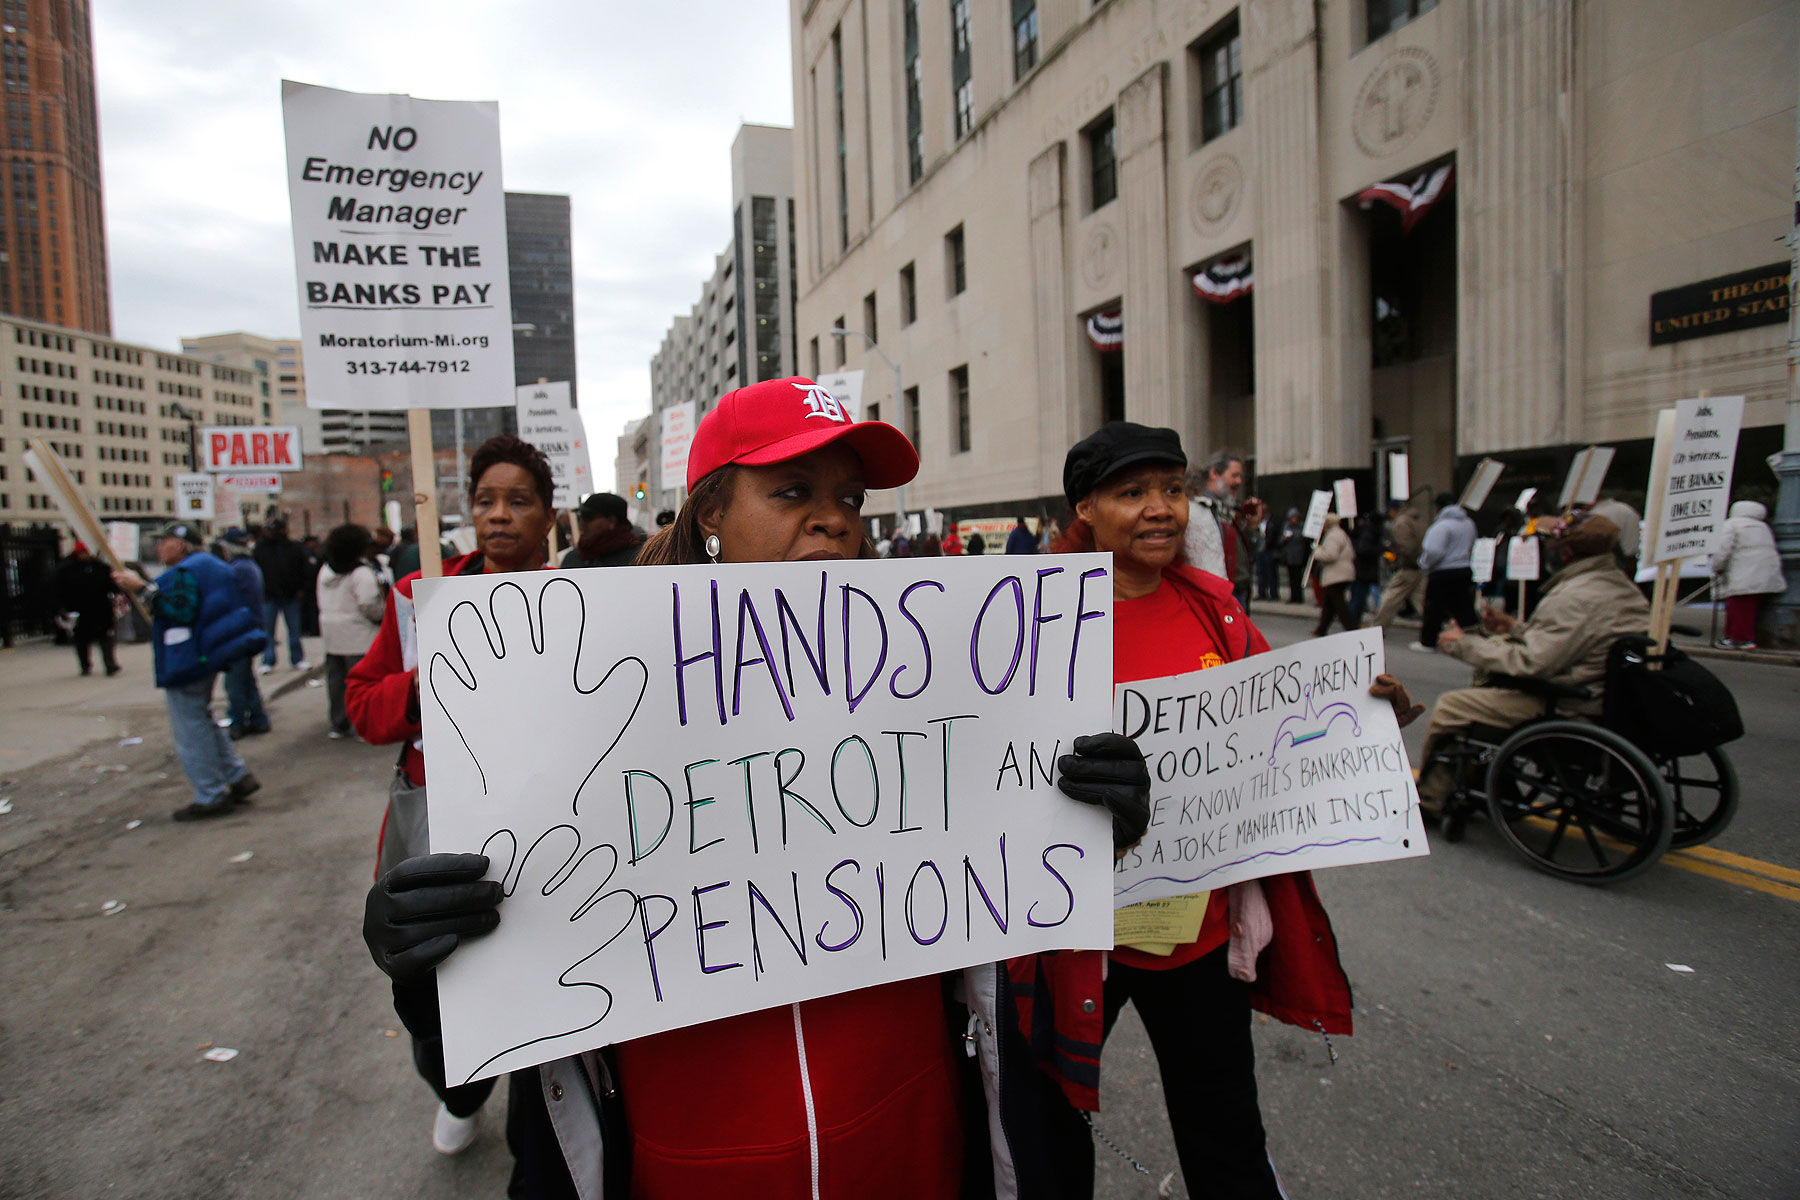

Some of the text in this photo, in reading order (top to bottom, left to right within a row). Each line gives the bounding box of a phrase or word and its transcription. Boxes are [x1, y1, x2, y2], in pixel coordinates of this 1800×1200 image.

[368, 126, 418, 152] NO
[302, 157, 483, 195] Emergency
[327, 196, 467, 230] Manager
[313, 241, 481, 268] MAKE THE
[306, 281, 491, 305] BANKS PAY
[1655, 307, 1731, 334] UNITED
[320, 333, 489, 349] Moratorium-Mi.org
[347, 360, 471, 376] 313-744-7912
[211, 433, 292, 466] PARK
[1670, 472, 1726, 491] THE BANKS
[1671, 502, 1689, 517] OWE
[672, 567, 1108, 726] HANDS OFF
[1122, 641, 1376, 740] DETROITERS AREN'T
[1143, 732, 1263, 783] OOLS...
[622, 714, 980, 867] DETROIT
[1180, 782, 1244, 825] KNOW
[1250, 763, 1292, 802] THIS
[1301, 741, 1405, 788] BANKRUPTCY
[1152, 840, 1164, 864] A
[1173, 823, 1229, 862] JOKE
[1235, 801, 1317, 849] MANHATTAN
[636, 833, 1085, 1002] PENSIONS
